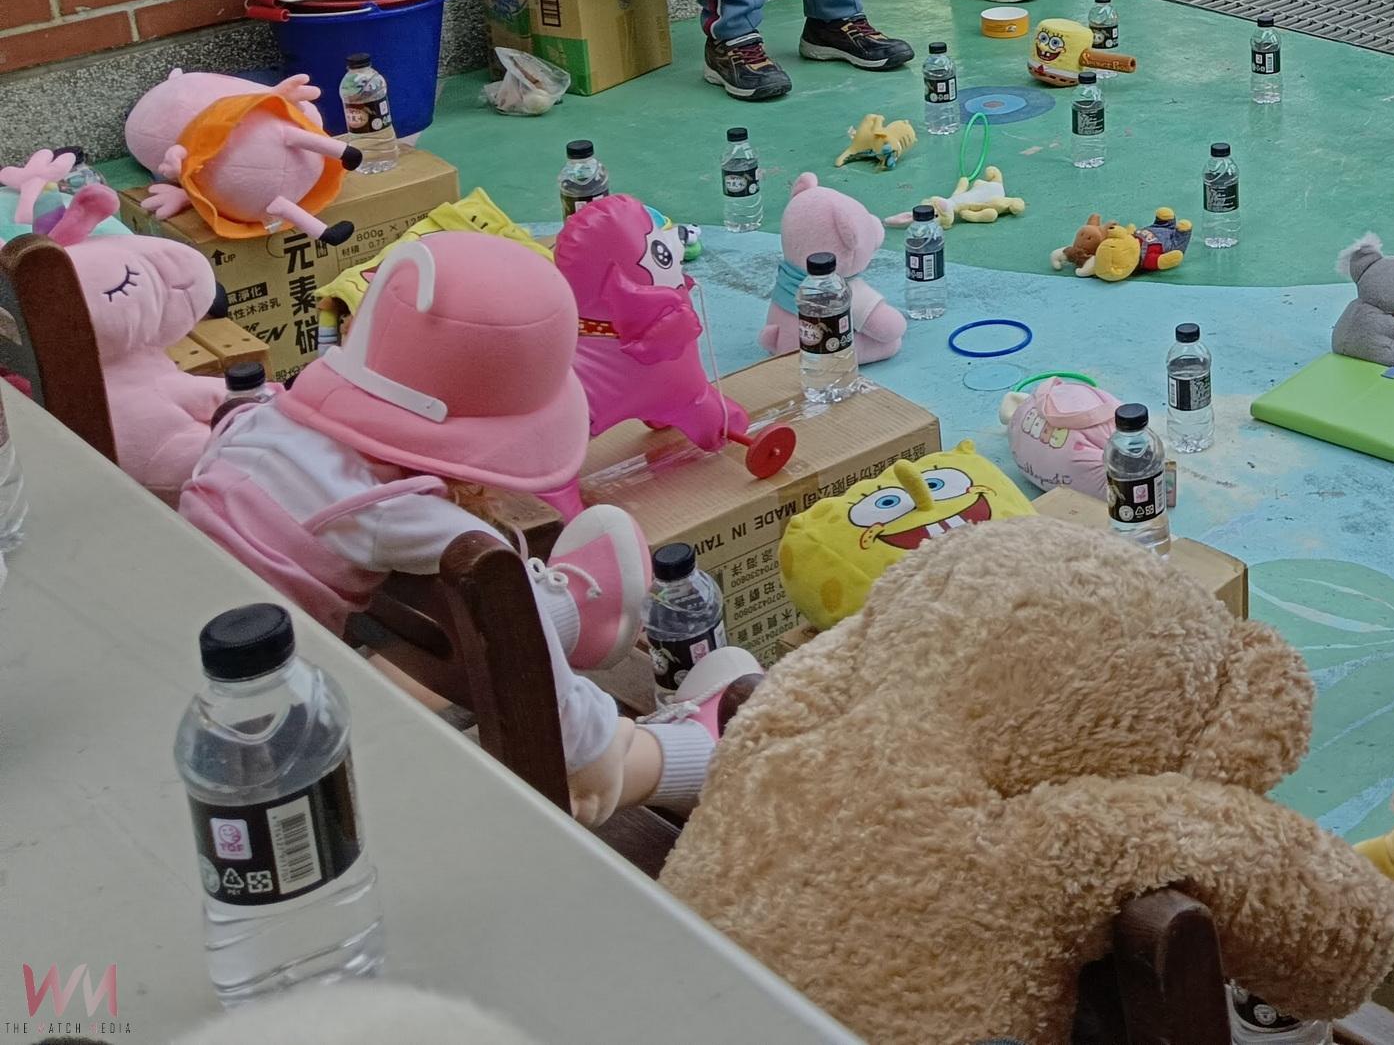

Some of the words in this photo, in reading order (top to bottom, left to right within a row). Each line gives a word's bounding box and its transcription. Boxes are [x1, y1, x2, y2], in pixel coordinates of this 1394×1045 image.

[223, 252, 236, 264] UP
[753, 499, 797, 530] MADE
[731, 522, 747, 541] IN
